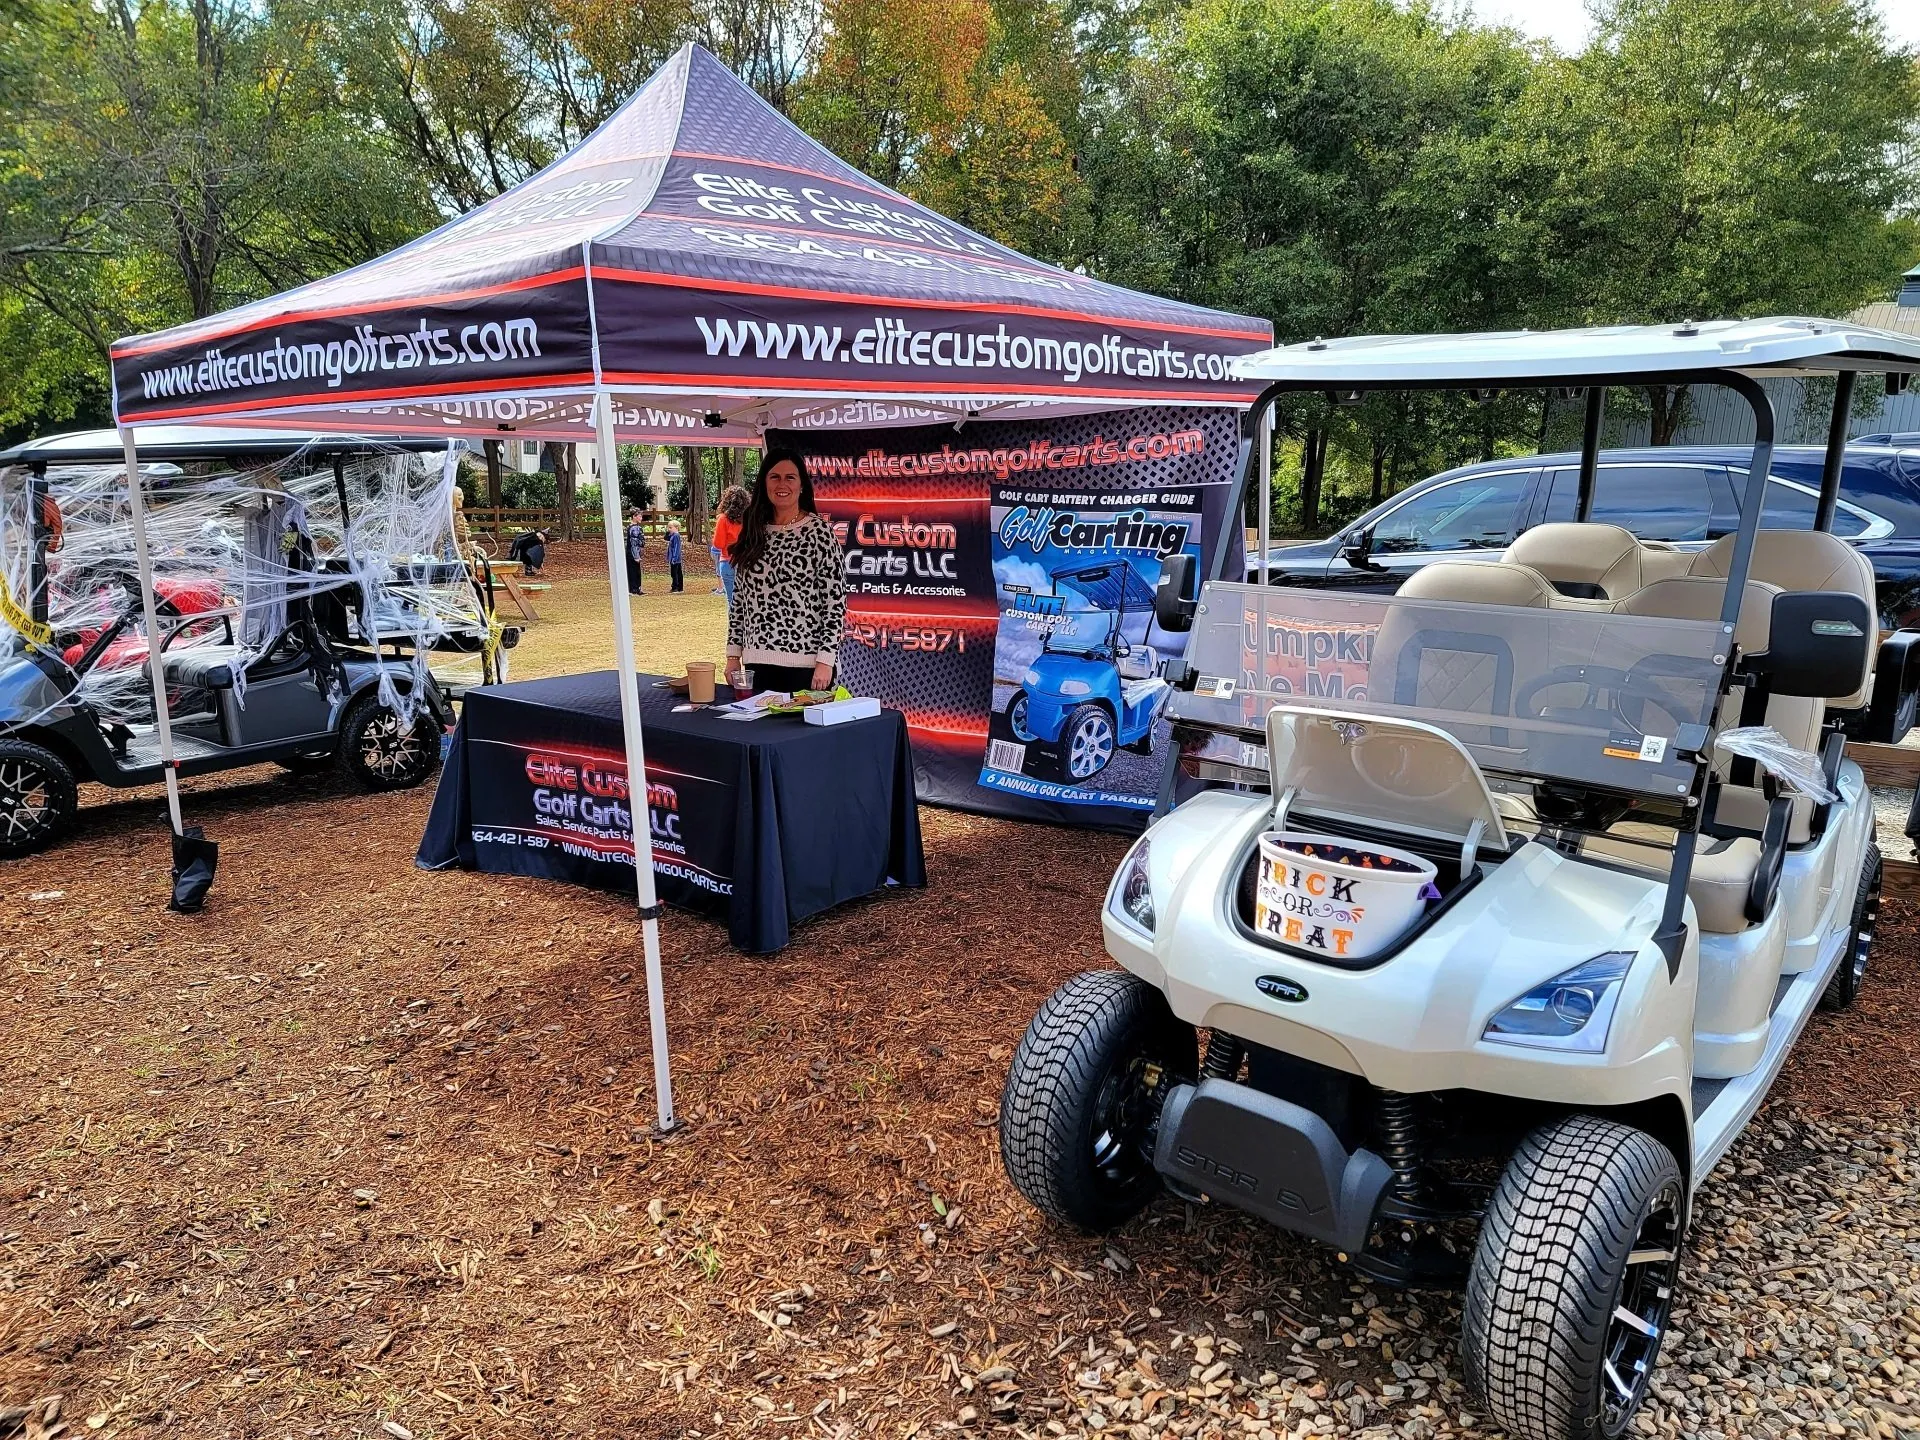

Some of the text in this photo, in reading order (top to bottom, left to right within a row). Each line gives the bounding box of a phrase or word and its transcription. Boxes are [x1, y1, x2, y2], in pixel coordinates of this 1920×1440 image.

[692, 172, 955, 237] Elite Custom
[697, 195, 806, 224] Golf
[809, 209, 925, 244] Carts
[141, 317, 542, 400] www.elitecustomgolfcarts.com
[999, 490, 1196, 506] GOLF CART BATTERY CHARGER GUIDE
[855, 513, 958, 549] Custom
[845, 549, 958, 578] Carts LLC
[1063, 549, 1152, 557] MAGAZINE
[862, 582, 891, 595] Parts
[892, 583, 902, 595] &
[903, 583, 967, 597] Accessories
[1005, 608, 1074, 626] CUSTOM GOLF
[1013, 592, 1067, 616] ELITE
[1059, 625, 1078, 637] LLC
[525, 753, 579, 791] Elite
[986, 773, 996, 784] 6
[995, 776, 1039, 794] ANNUAL
[1039, 785, 1062, 797] GOLF
[1061, 788, 1097, 801] CART
[533, 788, 578, 819] Golf
[579, 796, 632, 829] Carts
[535, 814, 561, 829] Sales,
[1261, 855, 1361, 904] TRICK
[1282, 892, 1314, 917] OR
[1255, 902, 1354, 955] TREAT
[1257, 978, 1300, 998] STAR
[1176, 1145, 1329, 1216] STAR EV
